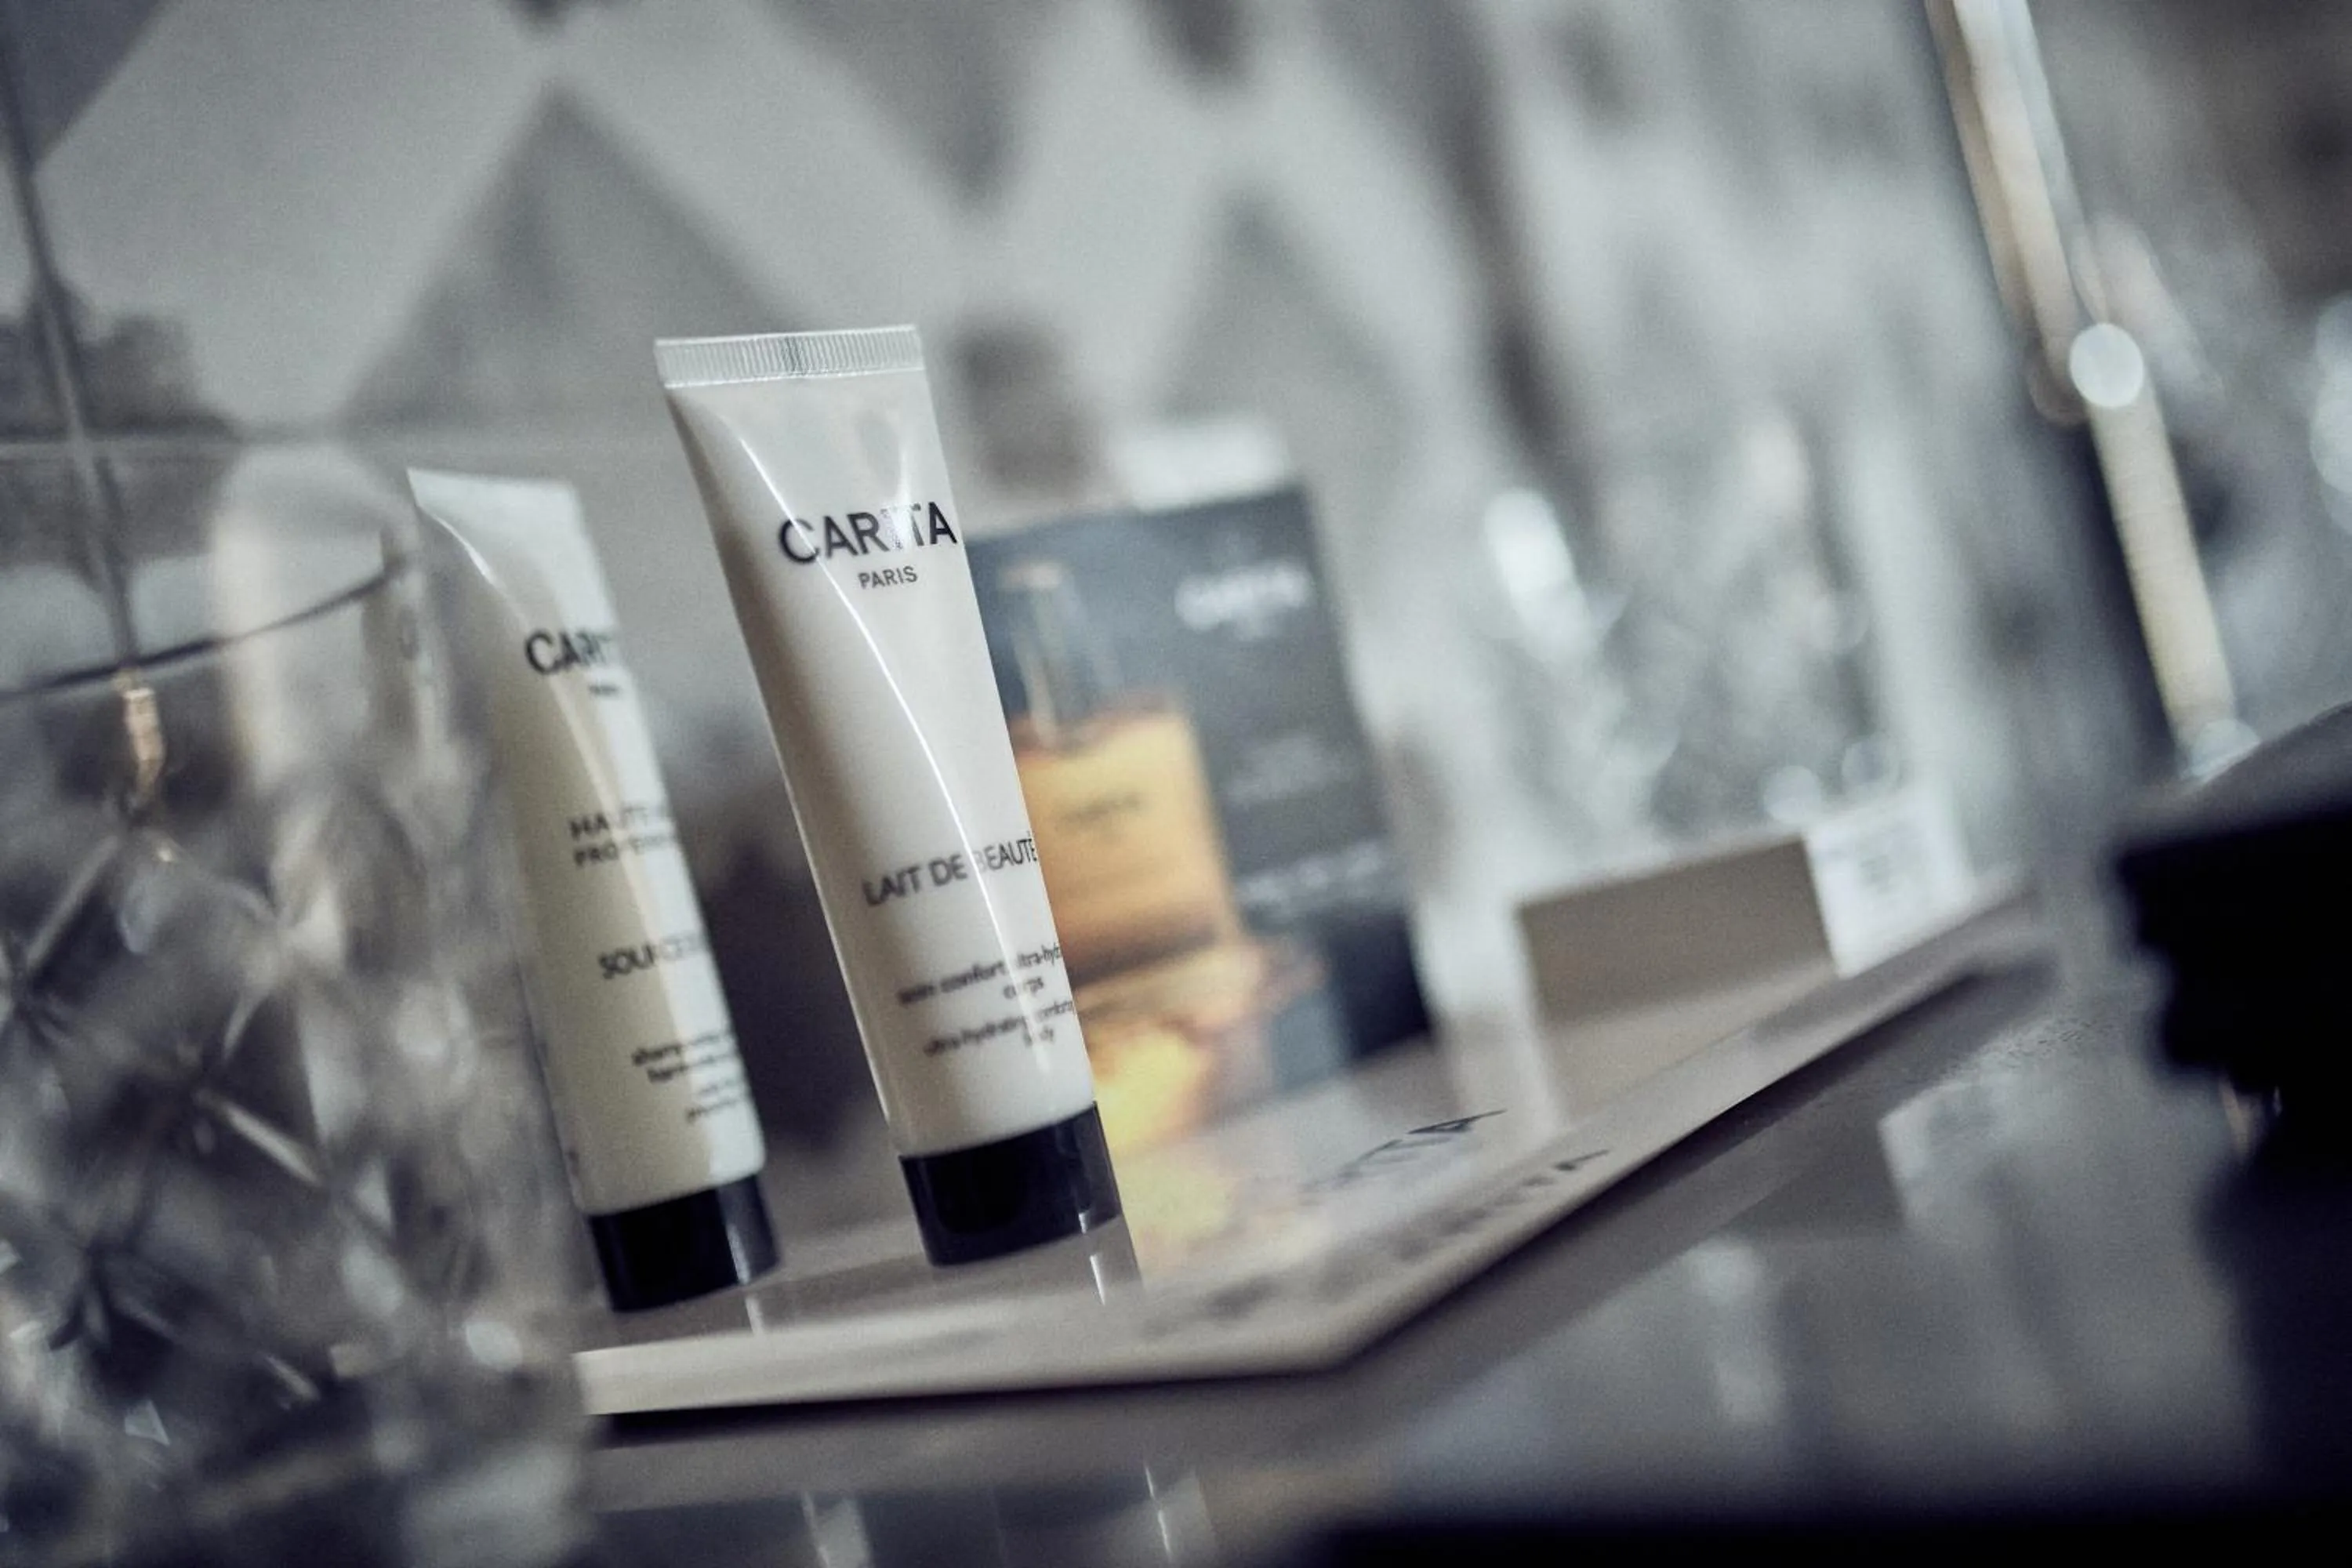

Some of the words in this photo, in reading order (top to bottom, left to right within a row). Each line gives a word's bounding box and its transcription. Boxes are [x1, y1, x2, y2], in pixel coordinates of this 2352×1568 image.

[779, 500, 958, 564] CARTA
[858, 566, 918, 589] PARIS
[862, 865, 922, 908] LAIT
[928, 852, 967, 887] DE
